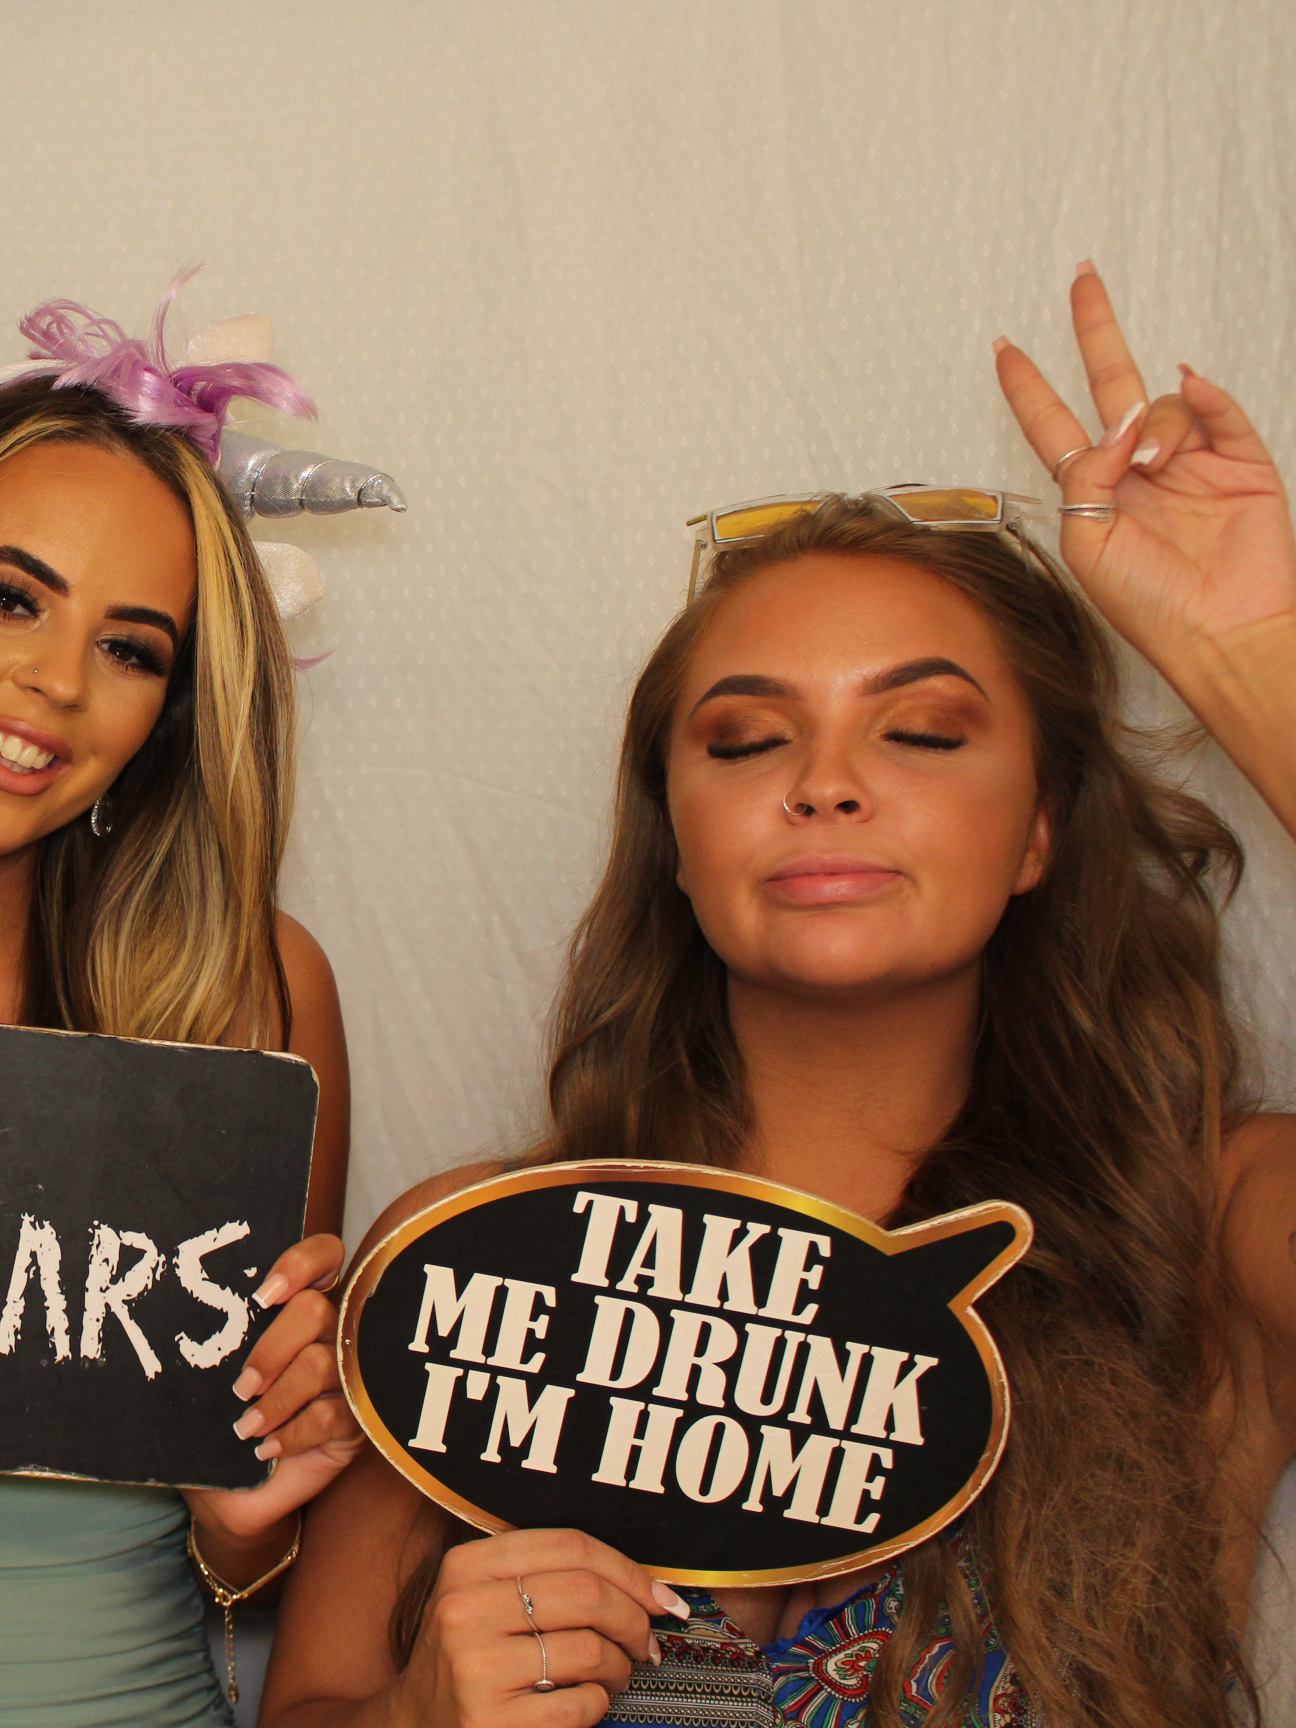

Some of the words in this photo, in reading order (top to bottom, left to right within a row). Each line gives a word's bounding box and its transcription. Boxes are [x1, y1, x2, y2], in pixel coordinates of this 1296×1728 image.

[571, 1191, 831, 1325] TAKE
[408, 1264, 557, 1374] ME
[576, 1295, 939, 1446] DRUNK
[408, 1363, 576, 1474] I'M
[592, 1397, 893, 1534] HOME
